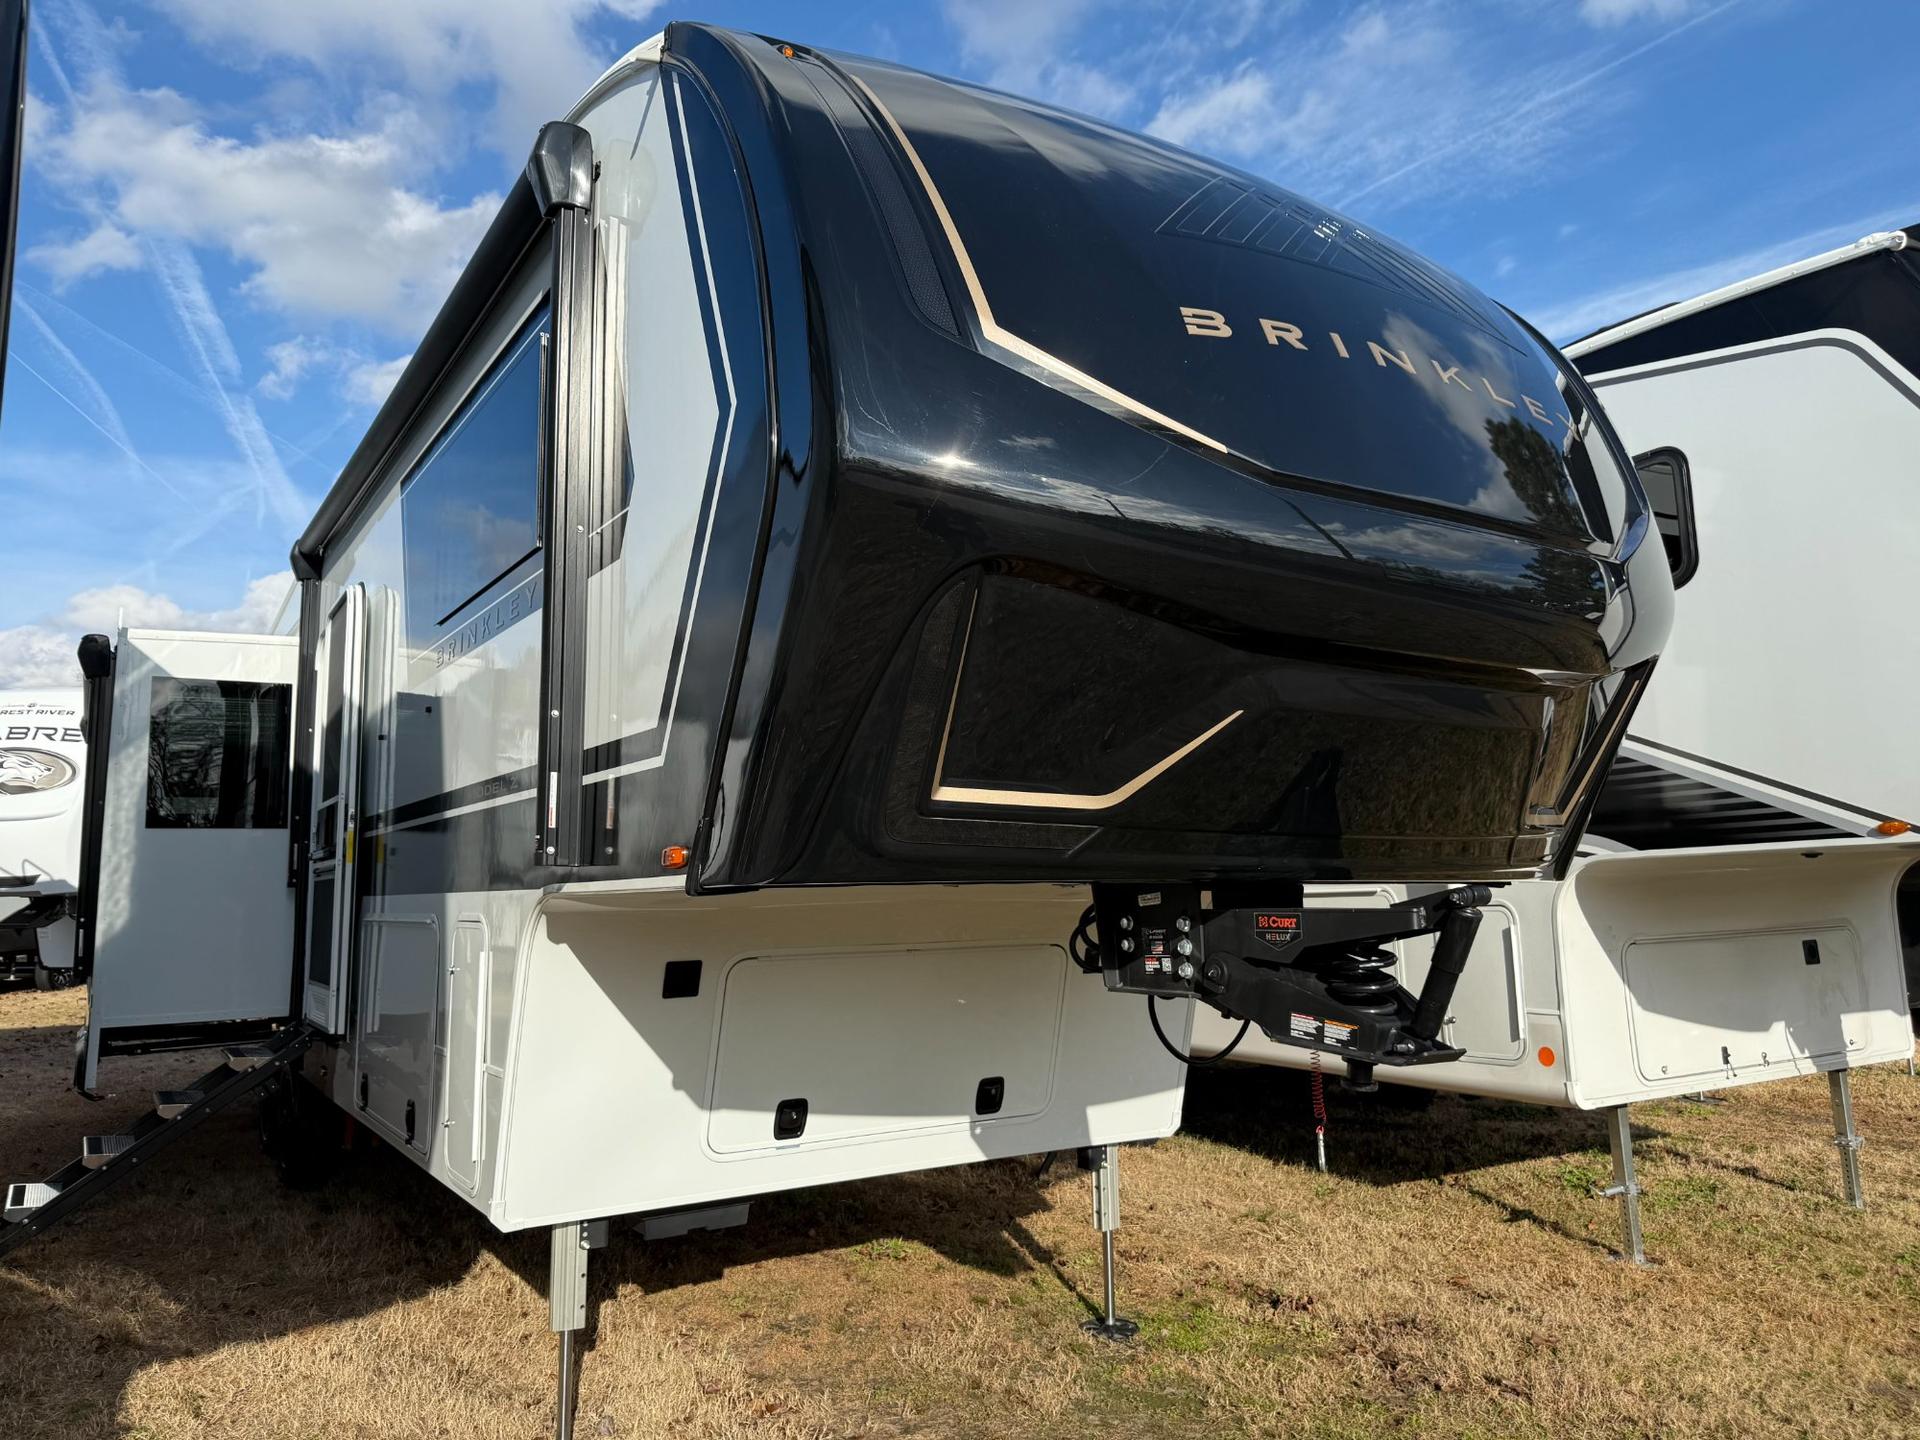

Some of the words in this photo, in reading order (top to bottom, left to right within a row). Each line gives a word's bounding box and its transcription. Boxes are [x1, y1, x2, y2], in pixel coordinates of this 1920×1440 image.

[1180, 306, 1581, 442] BRINKLEY
[436, 581, 538, 669] BRINKLEY
[35, 709, 76, 717] RIVER
[0, 726, 83, 743] BRE
[1269, 916, 1297, 928] CURT
[1265, 933, 1291, 941] HELUX
